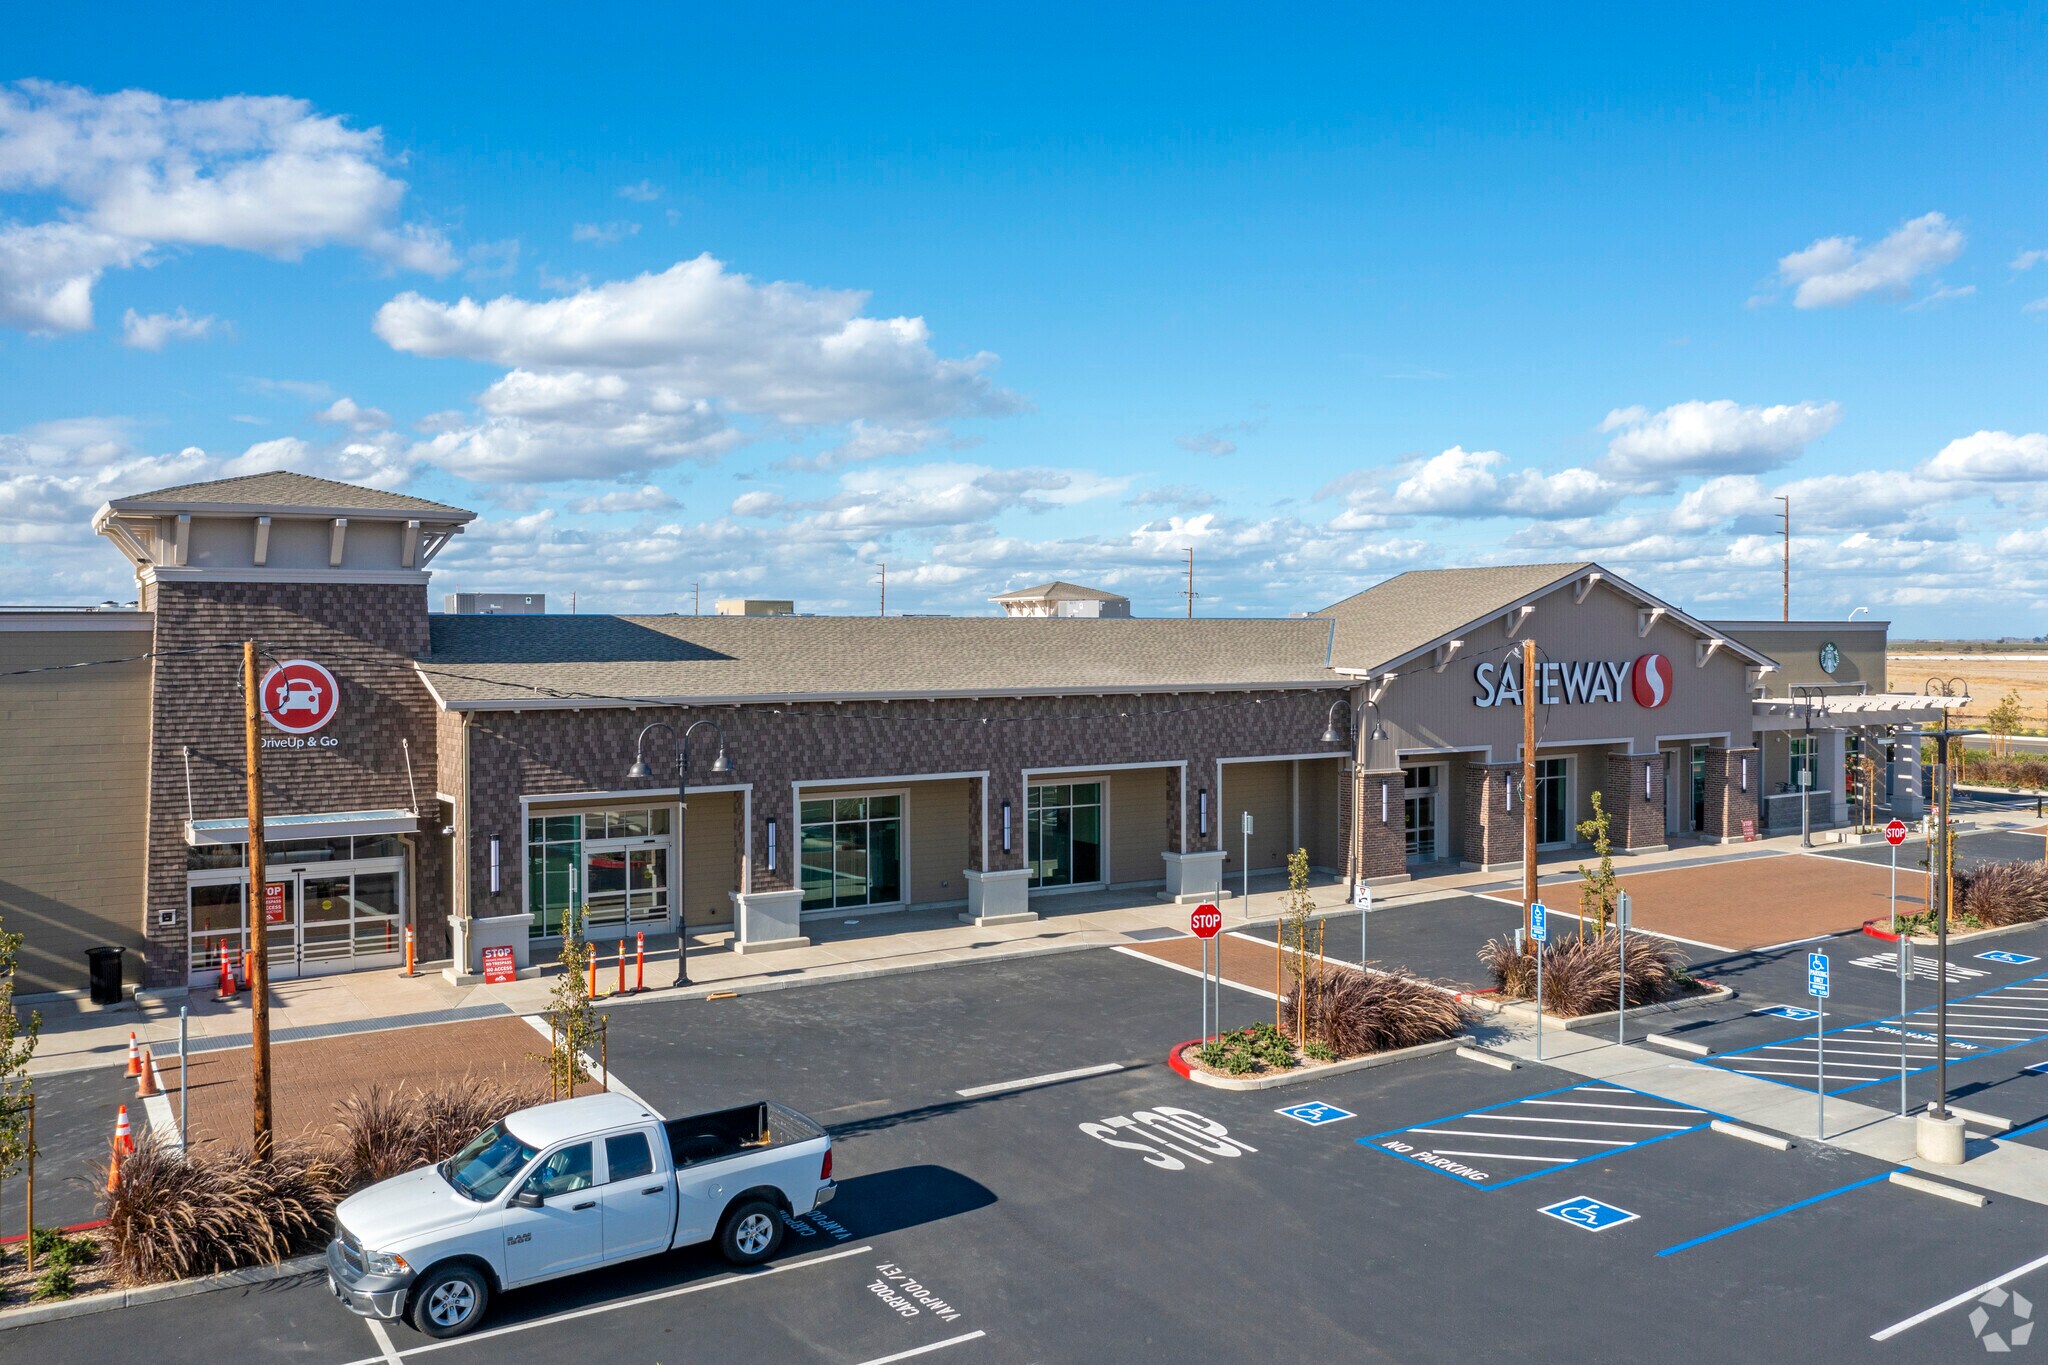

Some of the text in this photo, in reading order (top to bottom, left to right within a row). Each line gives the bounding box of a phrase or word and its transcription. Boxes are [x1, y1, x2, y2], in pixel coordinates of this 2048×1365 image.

[307, 736, 317, 747] &
[320, 736, 338, 747] Go
[1886, 827, 1905, 838] STOP
[266, 886, 281, 896] OP
[1192, 914, 1221, 929] STOP
[485, 948, 511, 958] STOP
[1078, 1106, 1259, 1171] STOP
[1382, 1140, 1489, 1181] NO PARKING
[806, 1209, 852, 1240] VANPOO
[867, 1279, 920, 1317] CARPOOL
[900, 1278, 961, 1322] VANPOOL
